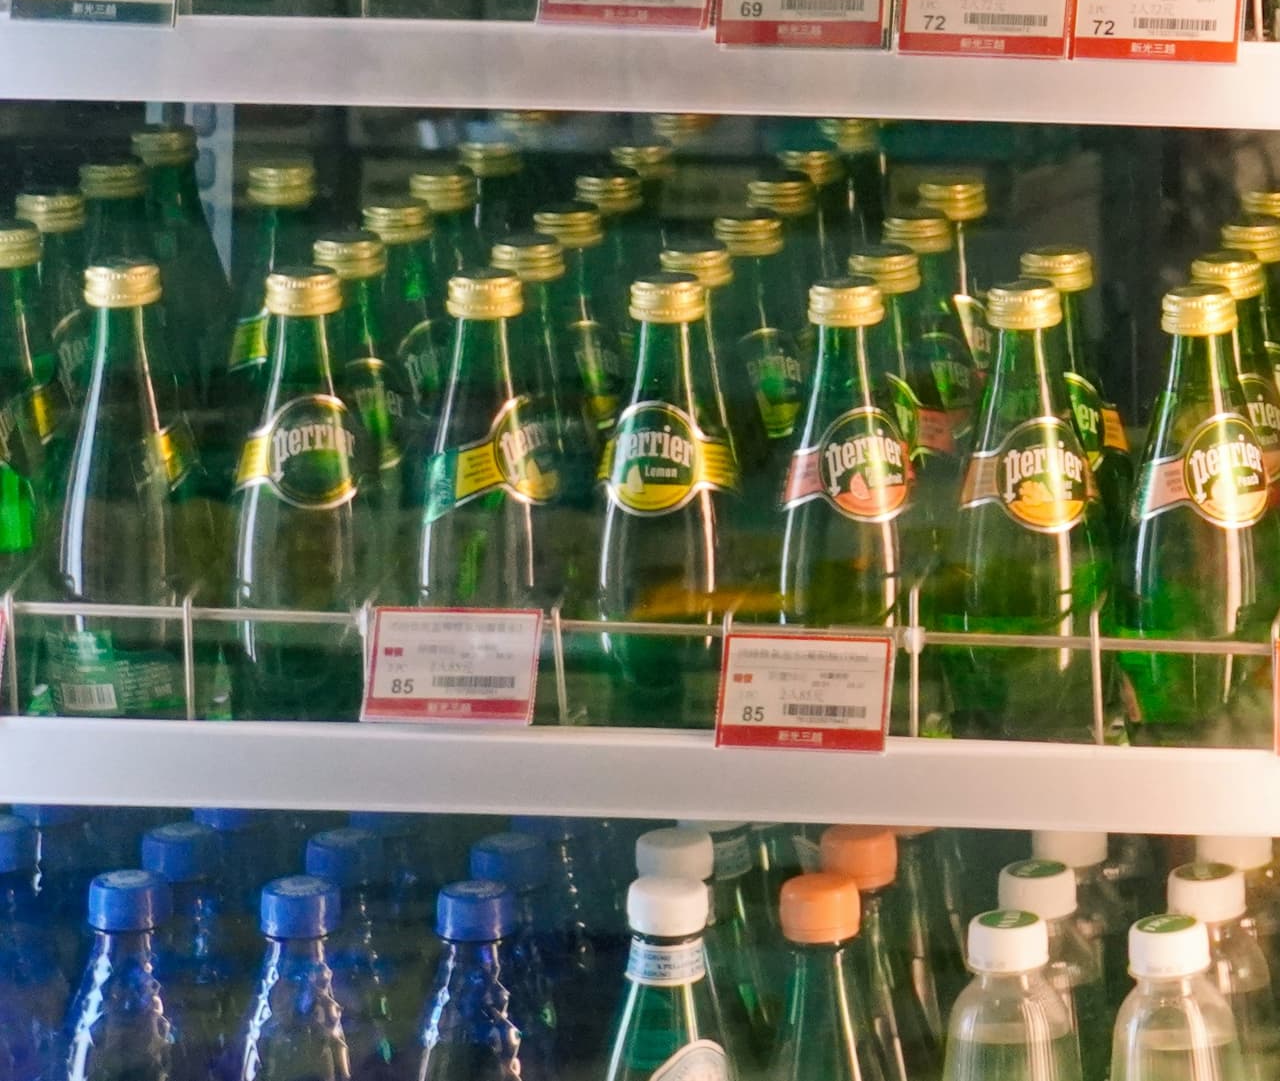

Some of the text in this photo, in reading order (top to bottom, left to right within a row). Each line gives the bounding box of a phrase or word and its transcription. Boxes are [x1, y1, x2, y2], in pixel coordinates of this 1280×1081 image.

[740, 0, 764, 18] 69
[922, 14, 946, 32] 72
[1091, 19, 1116, 36] 72
[959, 38, 1006, 51] 新光三越
[1130, 42, 1177, 56] 新光三越
[272, 418, 356, 483] perrier
[824, 428, 902, 495] perrier
[1189, 434, 1264, 506] perrier
[644, 464, 678, 479] Lemon
[1003, 440, 1082, 503] perrier
[391, 678, 415, 695] 85
[742, 706, 766, 723] 85
